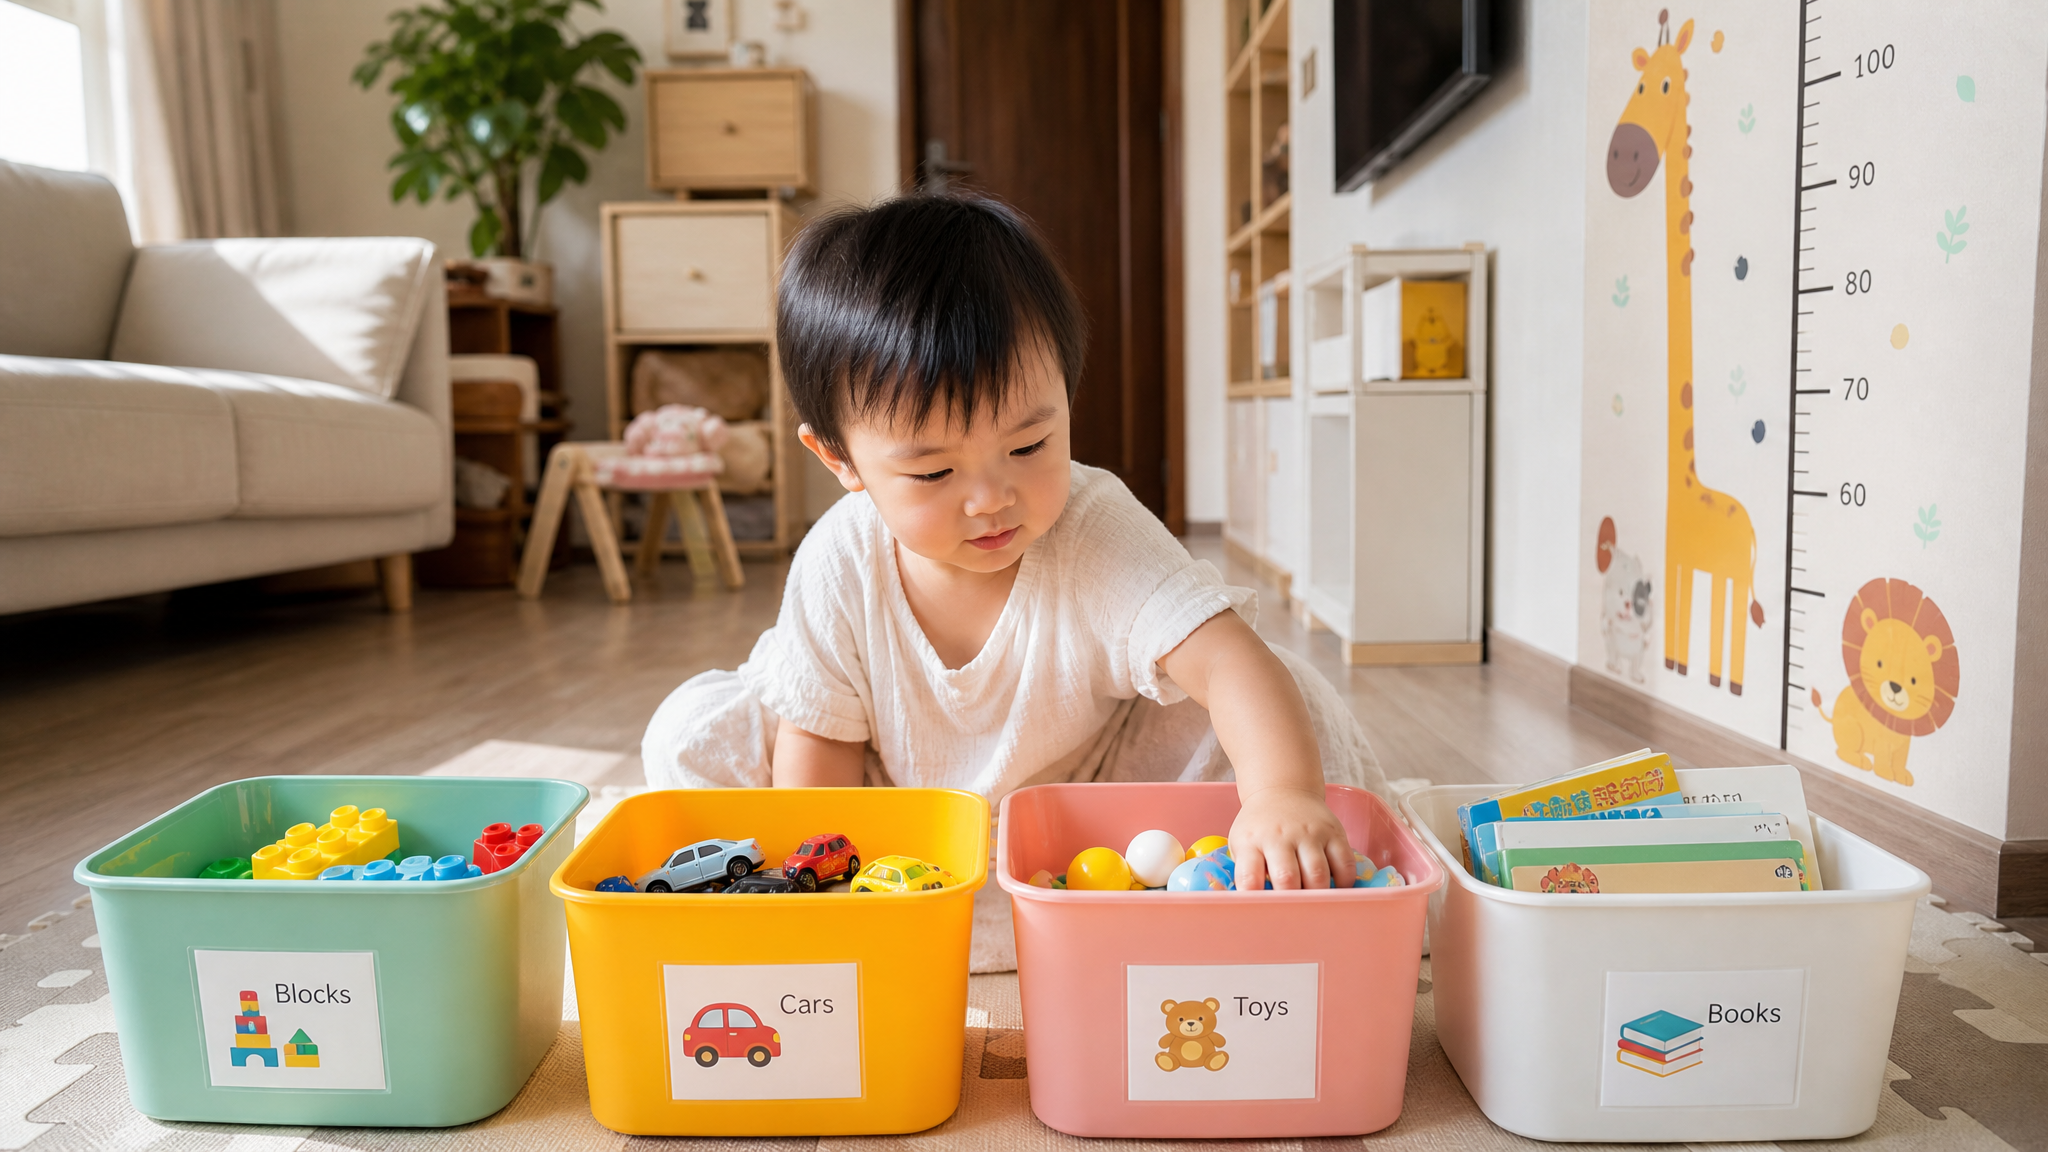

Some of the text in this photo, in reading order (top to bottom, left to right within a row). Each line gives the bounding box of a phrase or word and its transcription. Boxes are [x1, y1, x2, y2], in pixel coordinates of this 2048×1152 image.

[1854, 43, 1895, 79] 100
[1848, 161, 1875, 190] 90
[1845, 269, 1872, 296] 80
[1843, 376, 1869, 401] 70
[1840, 481, 1866, 507] 60
[275, 982, 352, 1004] Blocks
[780, 993, 834, 1015] Cars
[1233, 996, 1289, 1022] Toys
[1708, 1002, 1781, 1024] Books
